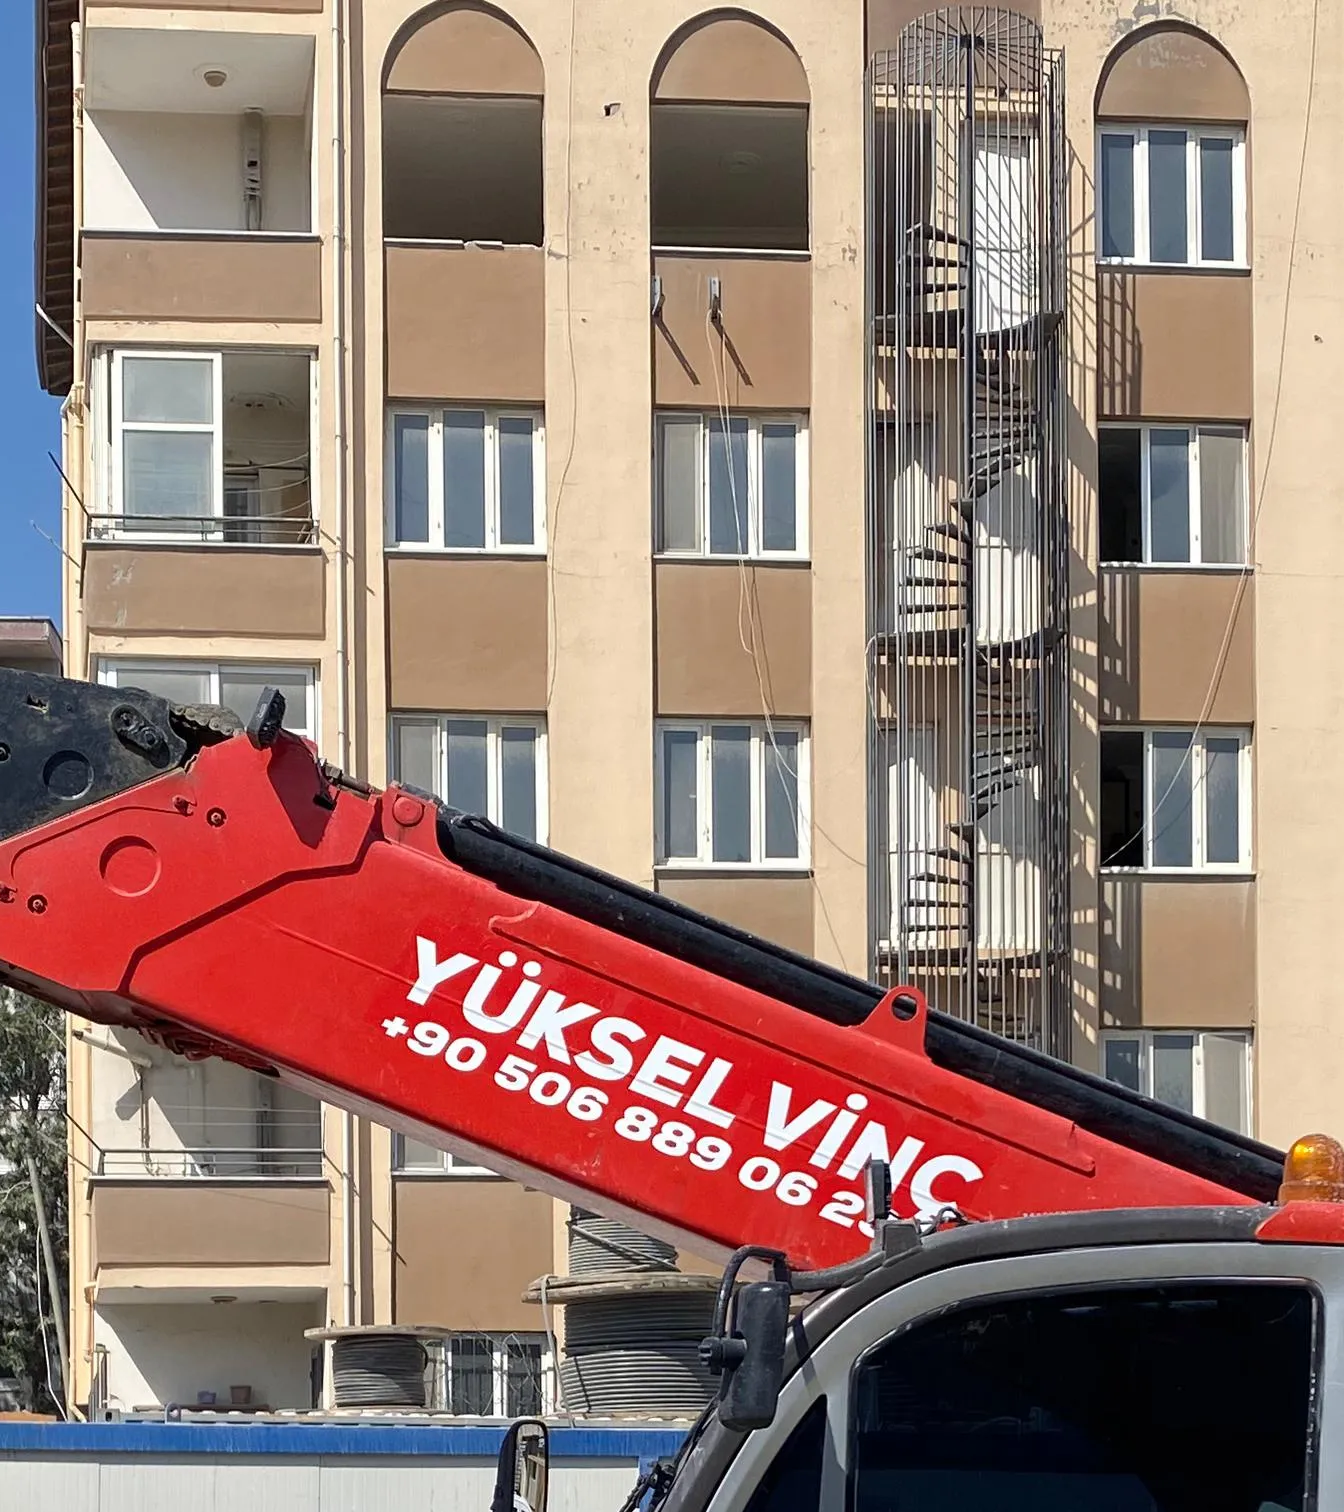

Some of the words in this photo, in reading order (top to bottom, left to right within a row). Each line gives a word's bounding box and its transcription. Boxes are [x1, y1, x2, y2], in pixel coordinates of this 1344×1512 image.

[381, 1016, 486, 1072] +90
[493, 1054, 609, 1122] 506
[614, 1105, 733, 1171] 889
[738, 1156, 818, 1206] 06
[818, 1190, 875, 1239] 2
[405, 935, 736, 1130] YÜKSEL
[763, 1080, 984, 1231] VİNÇ
